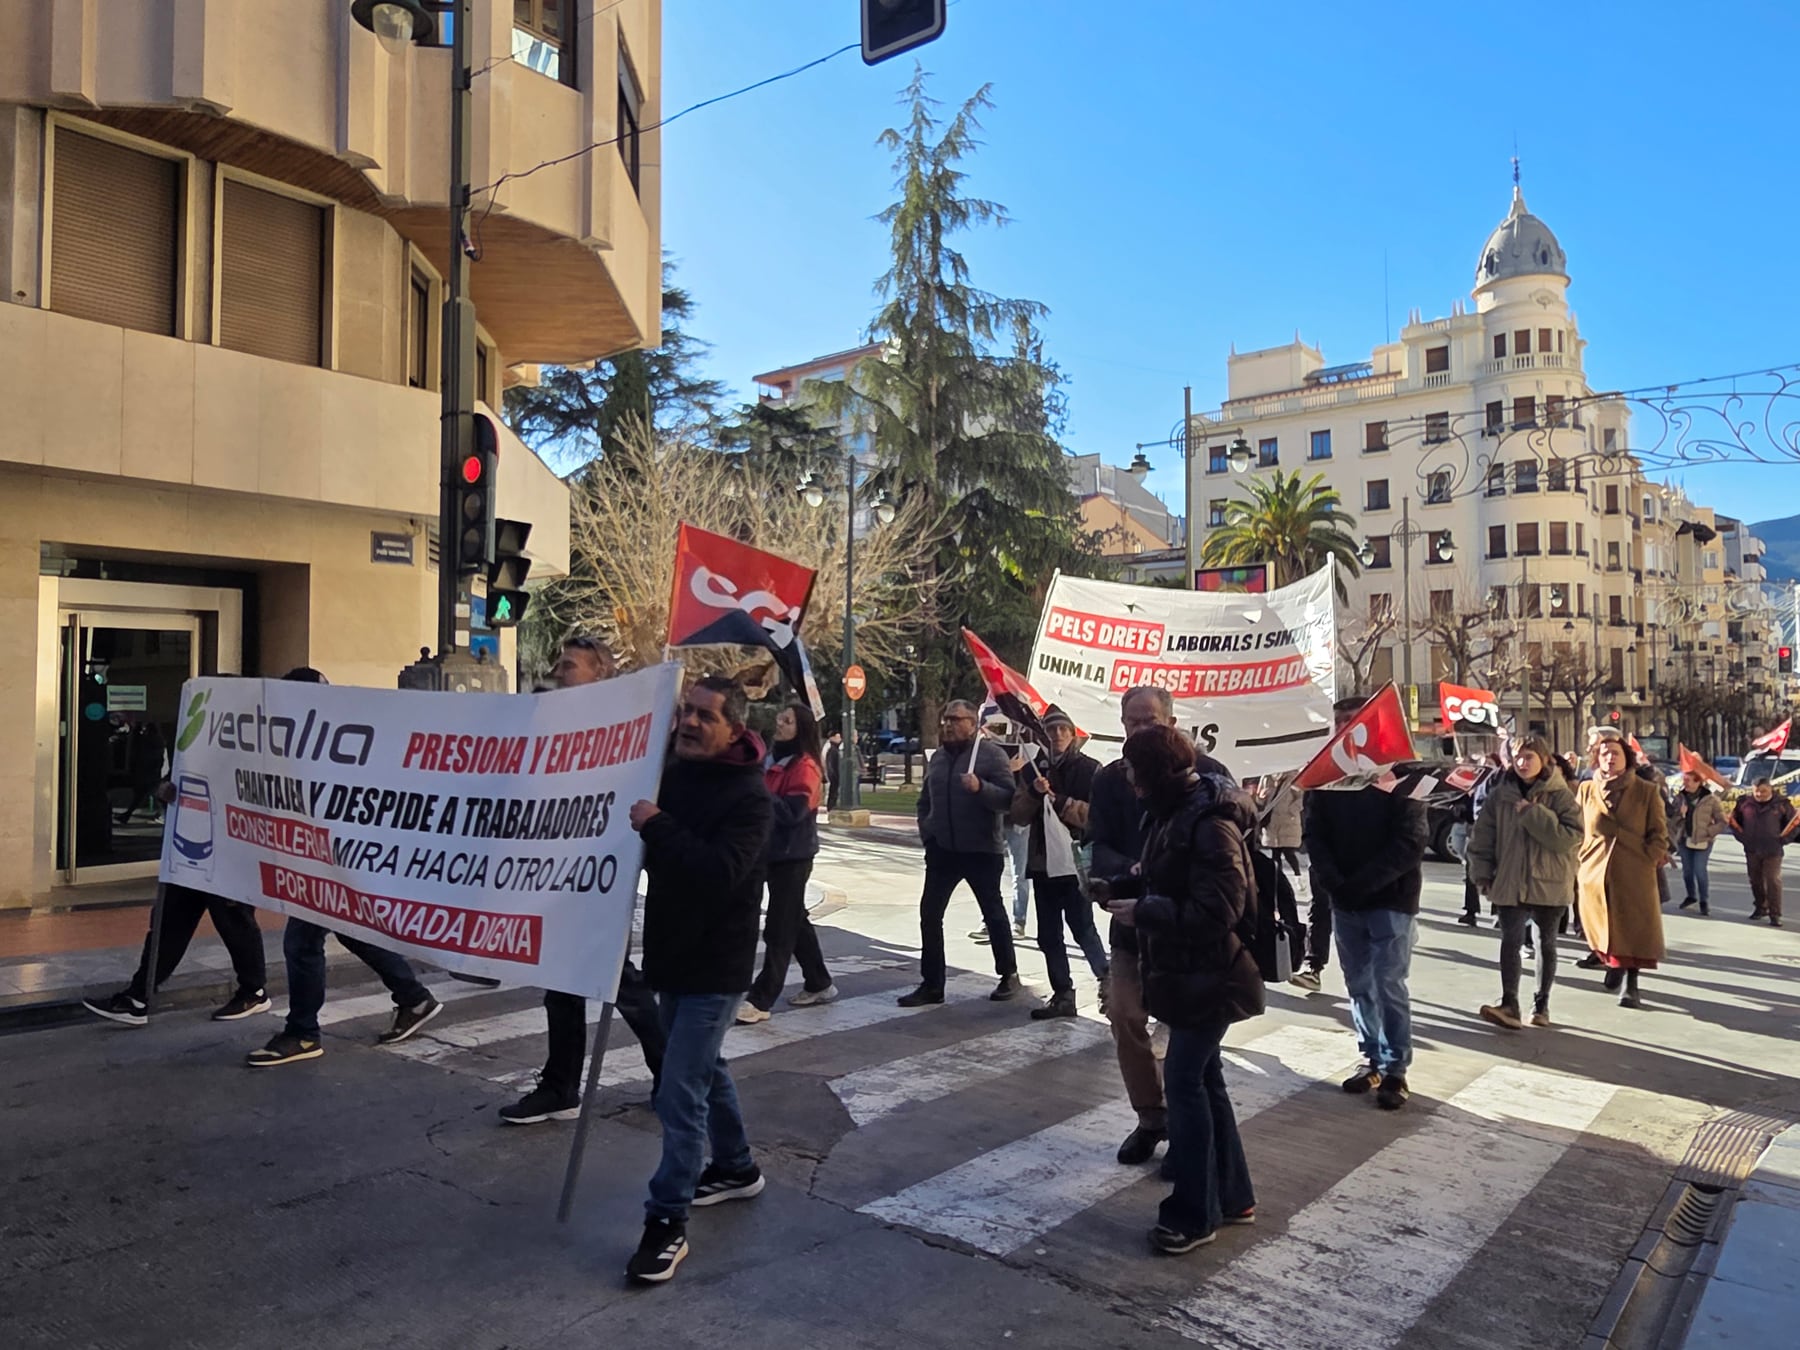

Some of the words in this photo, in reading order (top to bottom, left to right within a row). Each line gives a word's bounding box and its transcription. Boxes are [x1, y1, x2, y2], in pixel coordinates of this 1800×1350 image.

[1048, 612, 1096, 643] PELS
[1098, 623, 1161, 652] DRETS
[1166, 633, 1253, 652] LABORALS
[1254, 633, 1263, 650] I
[1039, 653, 1083, 679] UNIM
[1084, 664, 1106, 684] LA
[1115, 665, 1191, 693] CLASSE
[208, 703, 375, 766] vectalia
[402, 731, 529, 775] PRESIONA
[528, 735, 549, 775] Y
[544, 712, 653, 775] EXPEDIENTA
[1445, 696, 1499, 728] CGT
[234, 768, 307, 817] CHANTAJEA
[308, 780, 327, 819] Y
[324, 784, 440, 832] DESPIDE
[436, 796, 460, 836] A
[461, 791, 616, 841] TRABAJADORES
[228, 811, 331, 863] CONSELLERÍA
[331, 837, 401, 876] MIRA
[404, 848, 490, 888] HACIA
[275, 868, 309, 905] POR
[311, 880, 351, 917] UNA
[354, 893, 467, 946] JORNADA
[468, 914, 532, 957] DIGNA
